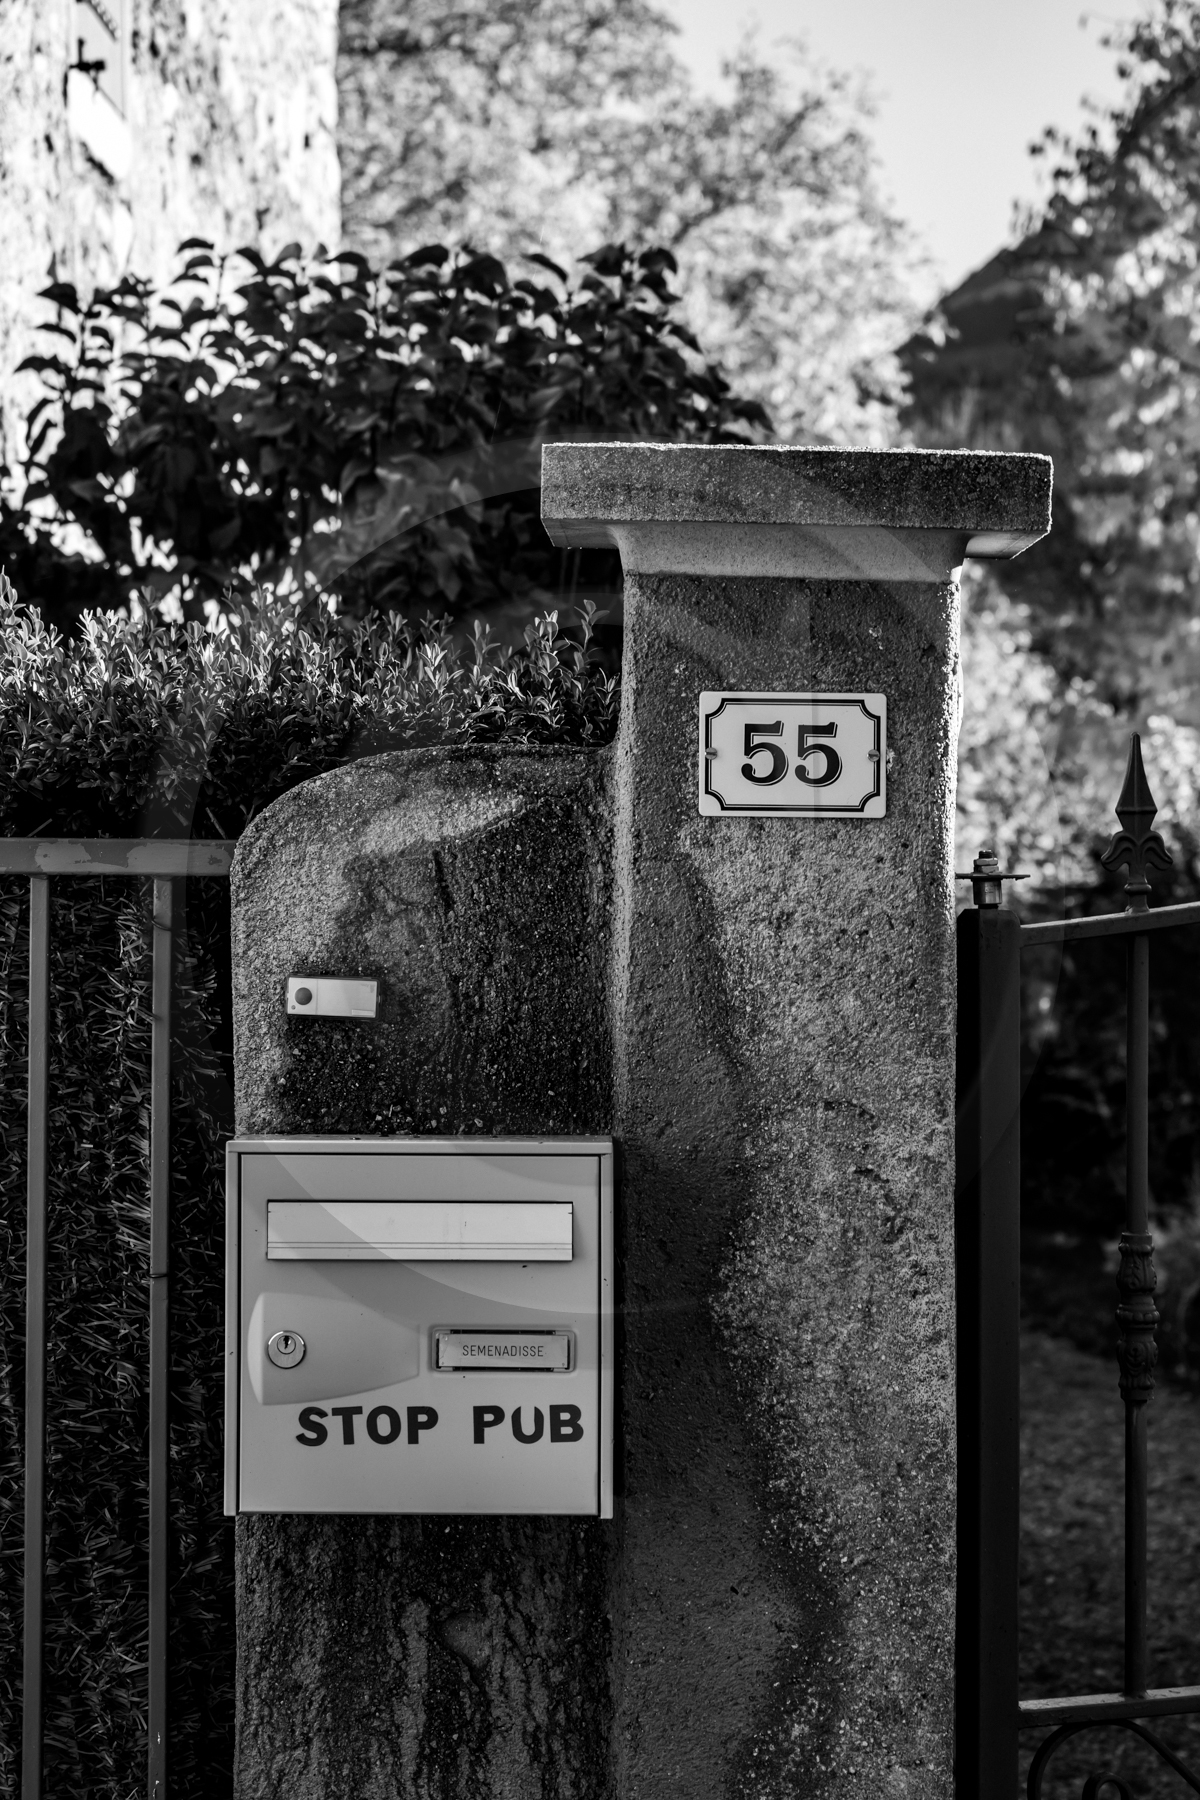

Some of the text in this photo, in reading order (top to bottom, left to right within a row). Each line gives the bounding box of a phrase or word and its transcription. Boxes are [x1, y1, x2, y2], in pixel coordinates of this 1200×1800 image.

[741, 720, 842, 787] 55
[462, 1345, 544, 1357] SEMENADISSE
[295, 1404, 584, 1446] STOP PUB
